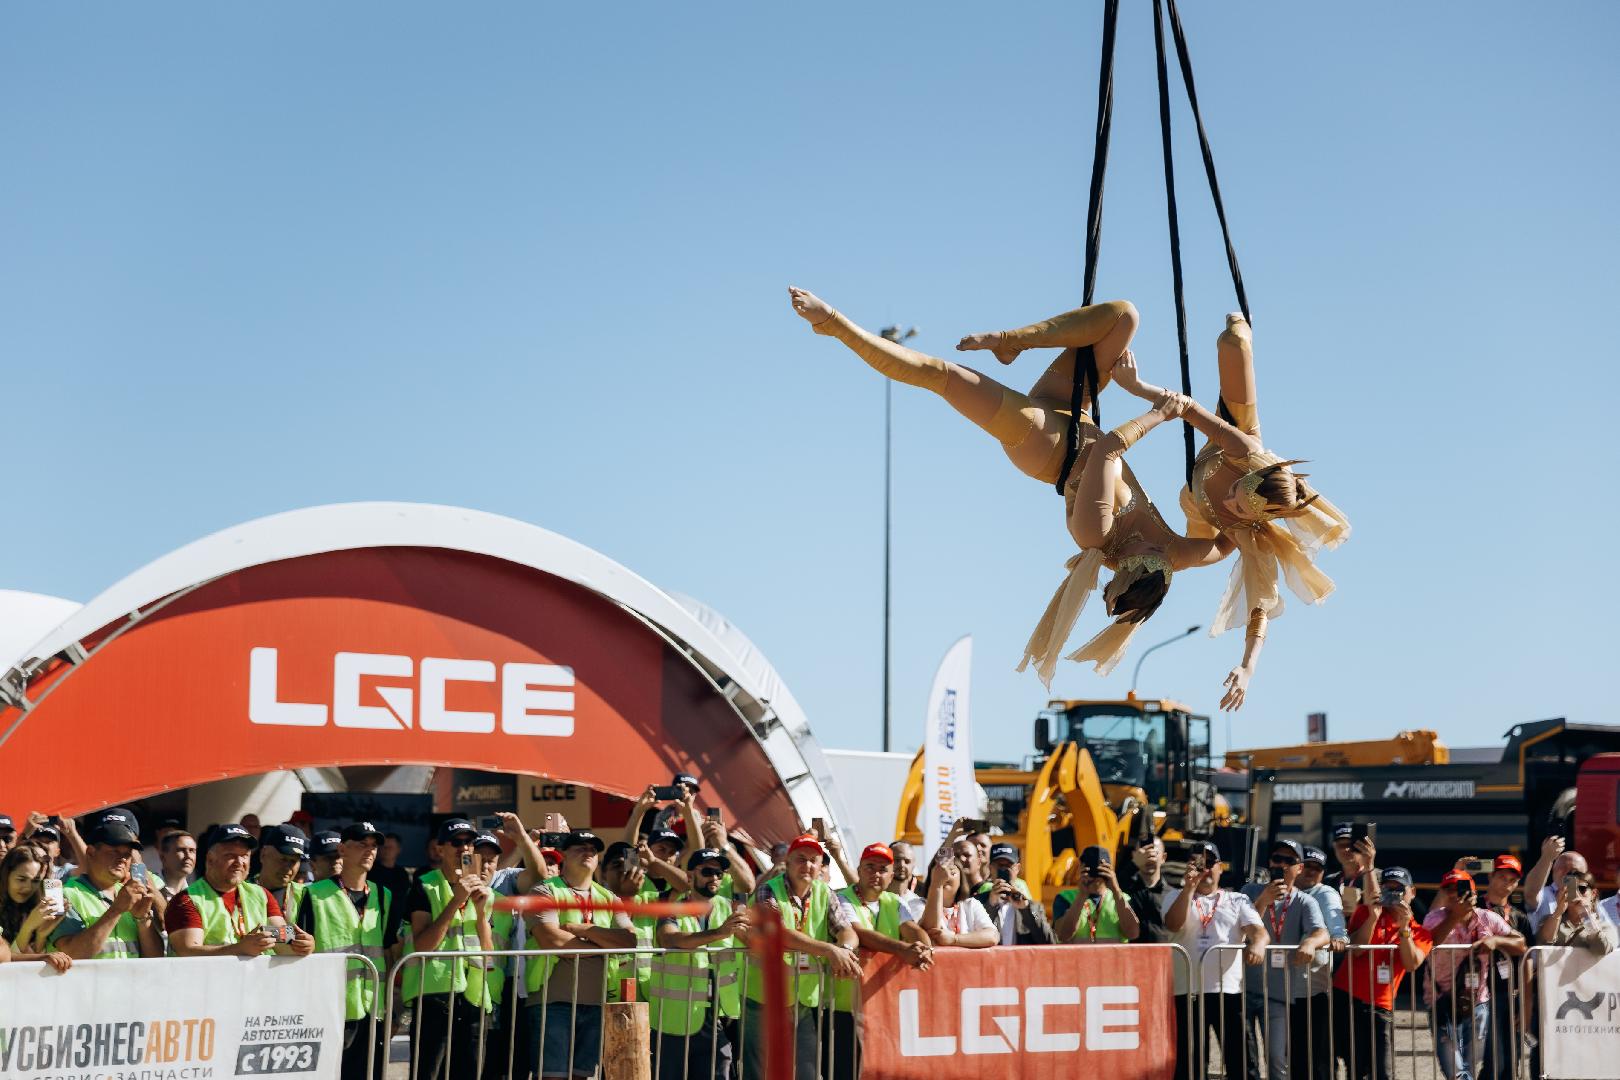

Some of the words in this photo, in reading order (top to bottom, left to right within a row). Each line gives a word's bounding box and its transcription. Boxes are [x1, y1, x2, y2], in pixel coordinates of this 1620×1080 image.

[248, 646, 576, 737] LGCE
[531, 784, 576, 800] LGCE
[245, 1016, 260, 1028] НА
[263, 1014, 304, 1026] РЫНКЕ
[899, 986, 1140, 1056] LGCE
[241, 1028, 324, 1042] АВТОТЕХНИКИ
[258, 1045, 312, 1071] 1993
